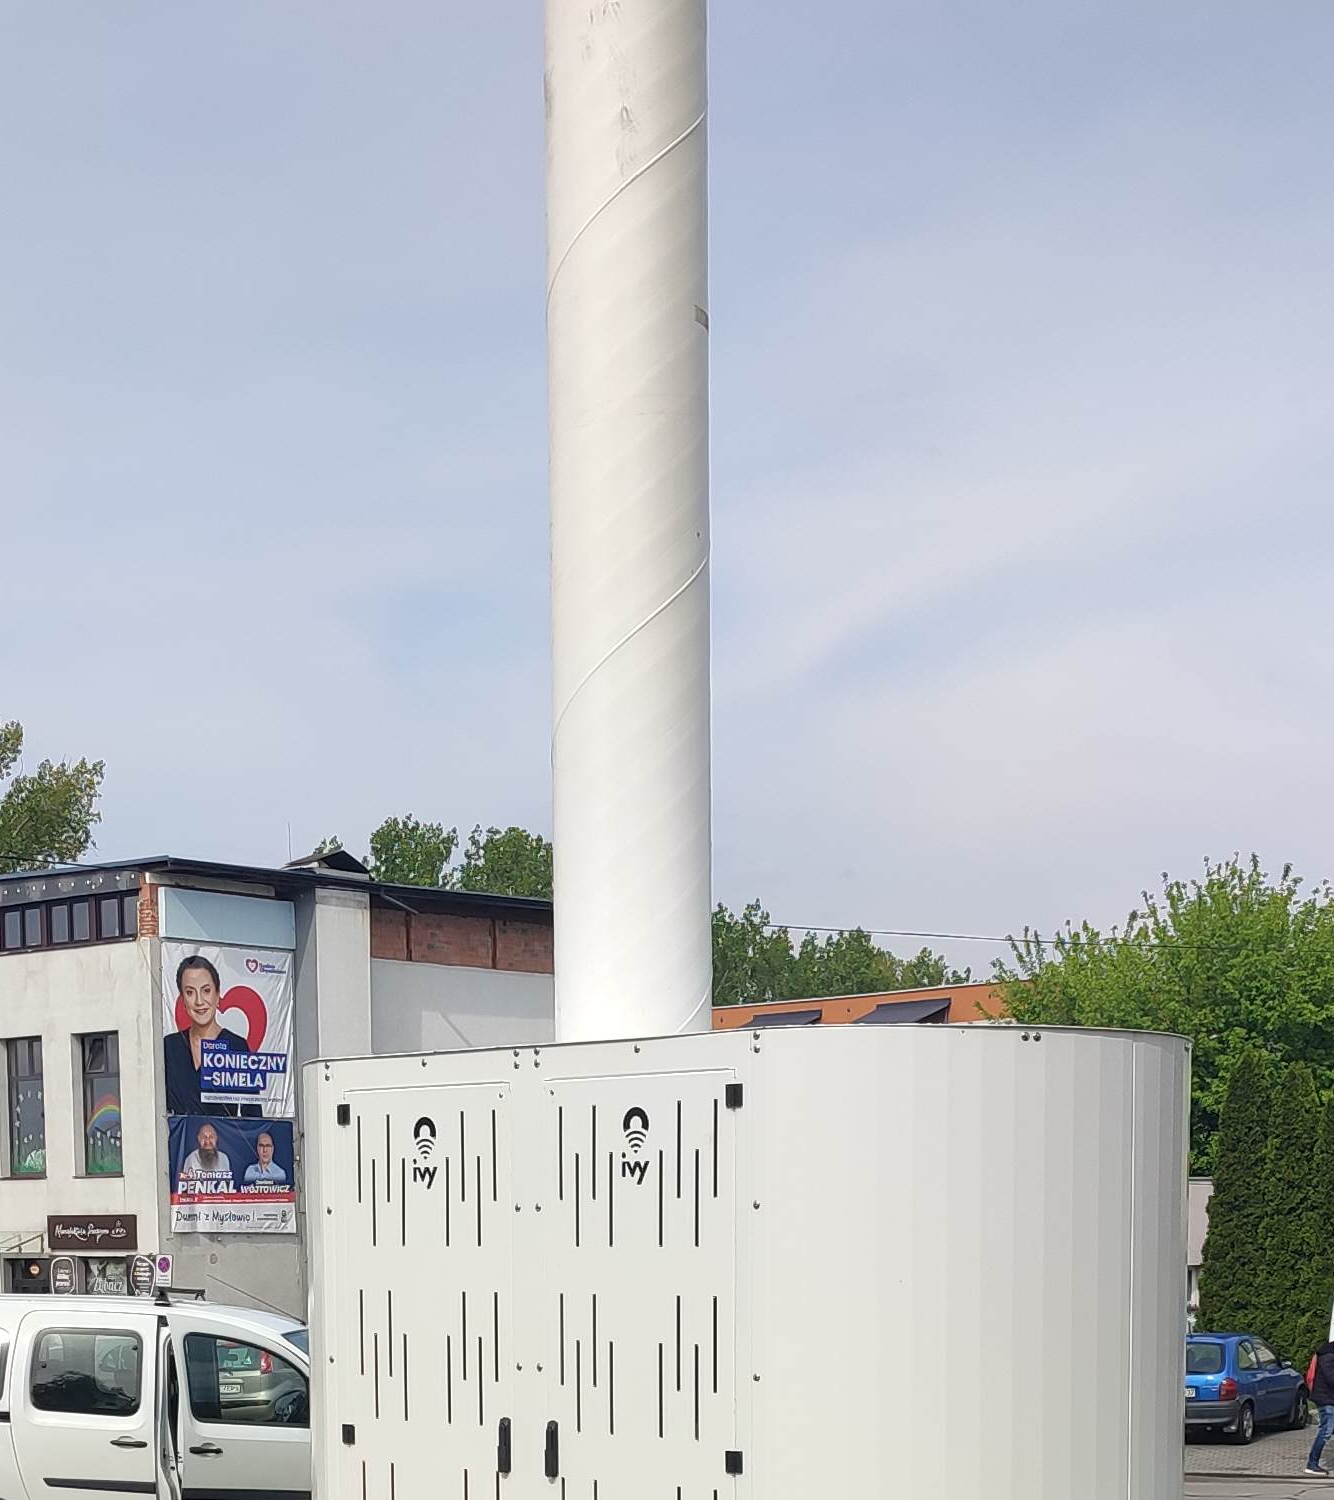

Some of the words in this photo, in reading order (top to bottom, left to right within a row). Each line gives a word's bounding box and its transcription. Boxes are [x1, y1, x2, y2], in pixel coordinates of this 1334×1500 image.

[203, 1053, 286, 1071] KONIECZNY
[203, 1071, 264, 1088] -SIMELA
[196, 1170, 233, 1179] Tomasz
[412, 1158, 438, 1190] ivy
[621, 1152, 650, 1185] ivy
[177, 1180, 237, 1194] PENKAL
[240, 1183, 291, 1194] WÓJTOWICZ
